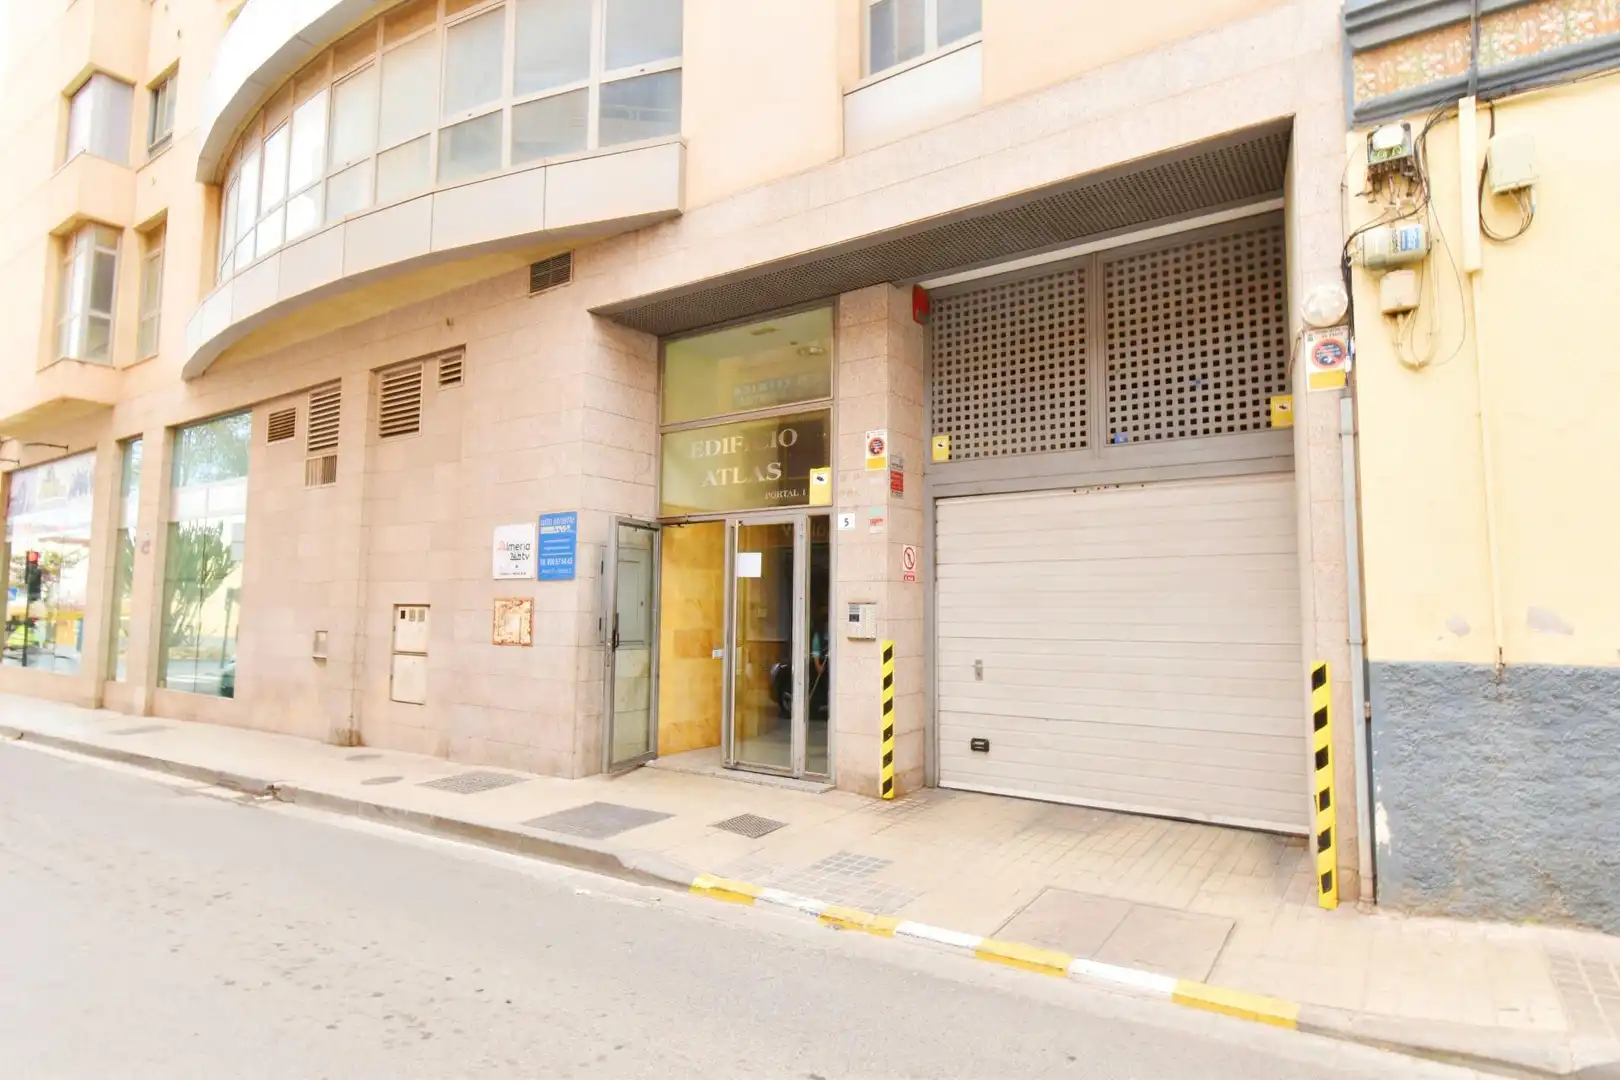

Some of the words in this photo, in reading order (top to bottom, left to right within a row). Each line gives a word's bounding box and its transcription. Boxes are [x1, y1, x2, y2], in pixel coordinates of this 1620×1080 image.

[691, 428, 797, 457] EDIFIO
[702, 461, 782, 487] ATLAS
[764, 489, 799, 499] PORTAL
[844, 518, 850, 526] 5
